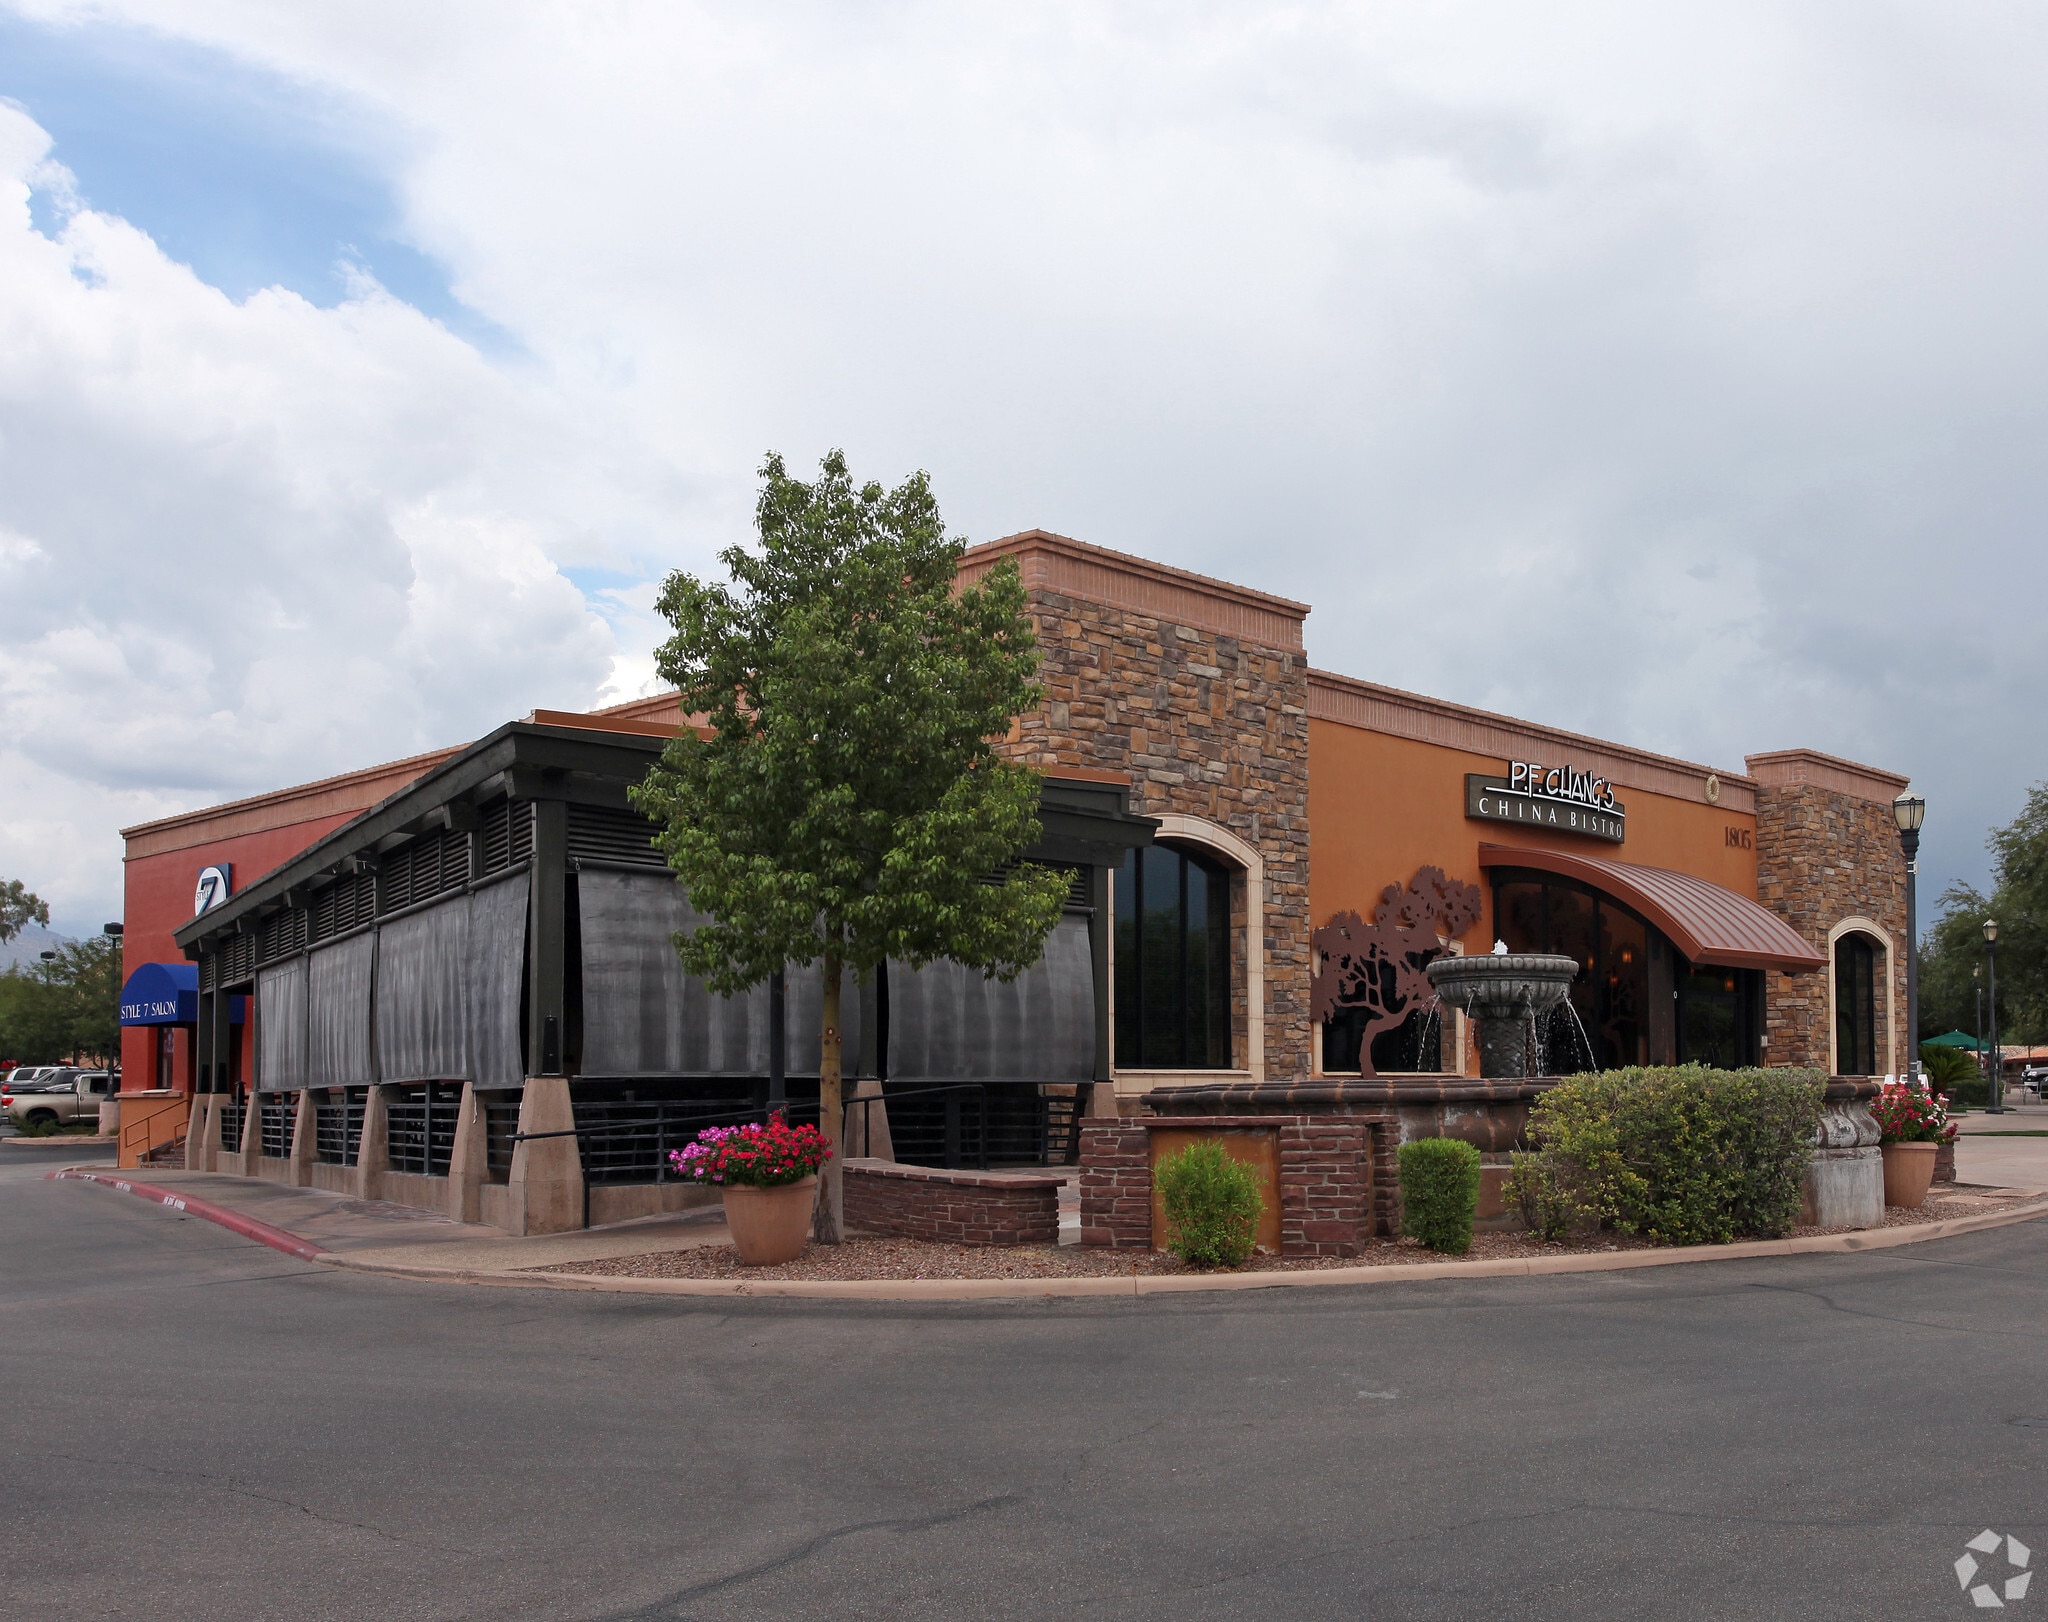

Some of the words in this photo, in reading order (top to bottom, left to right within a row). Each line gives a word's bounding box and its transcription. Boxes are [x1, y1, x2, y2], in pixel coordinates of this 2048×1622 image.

[1510, 760, 1542, 798] P.F.
[1545, 764, 1616, 812] CHANG'S
[1478, 797, 1557, 824] CHINA
[1570, 811, 1623, 839] BISTRO
[1724, 825, 1752, 850] 1805
[200, 876, 218, 913] 7
[121, 1004, 141, 1019] STYLE
[144, 1003, 149, 1017] 7
[151, 1001, 176, 1016] SALON
